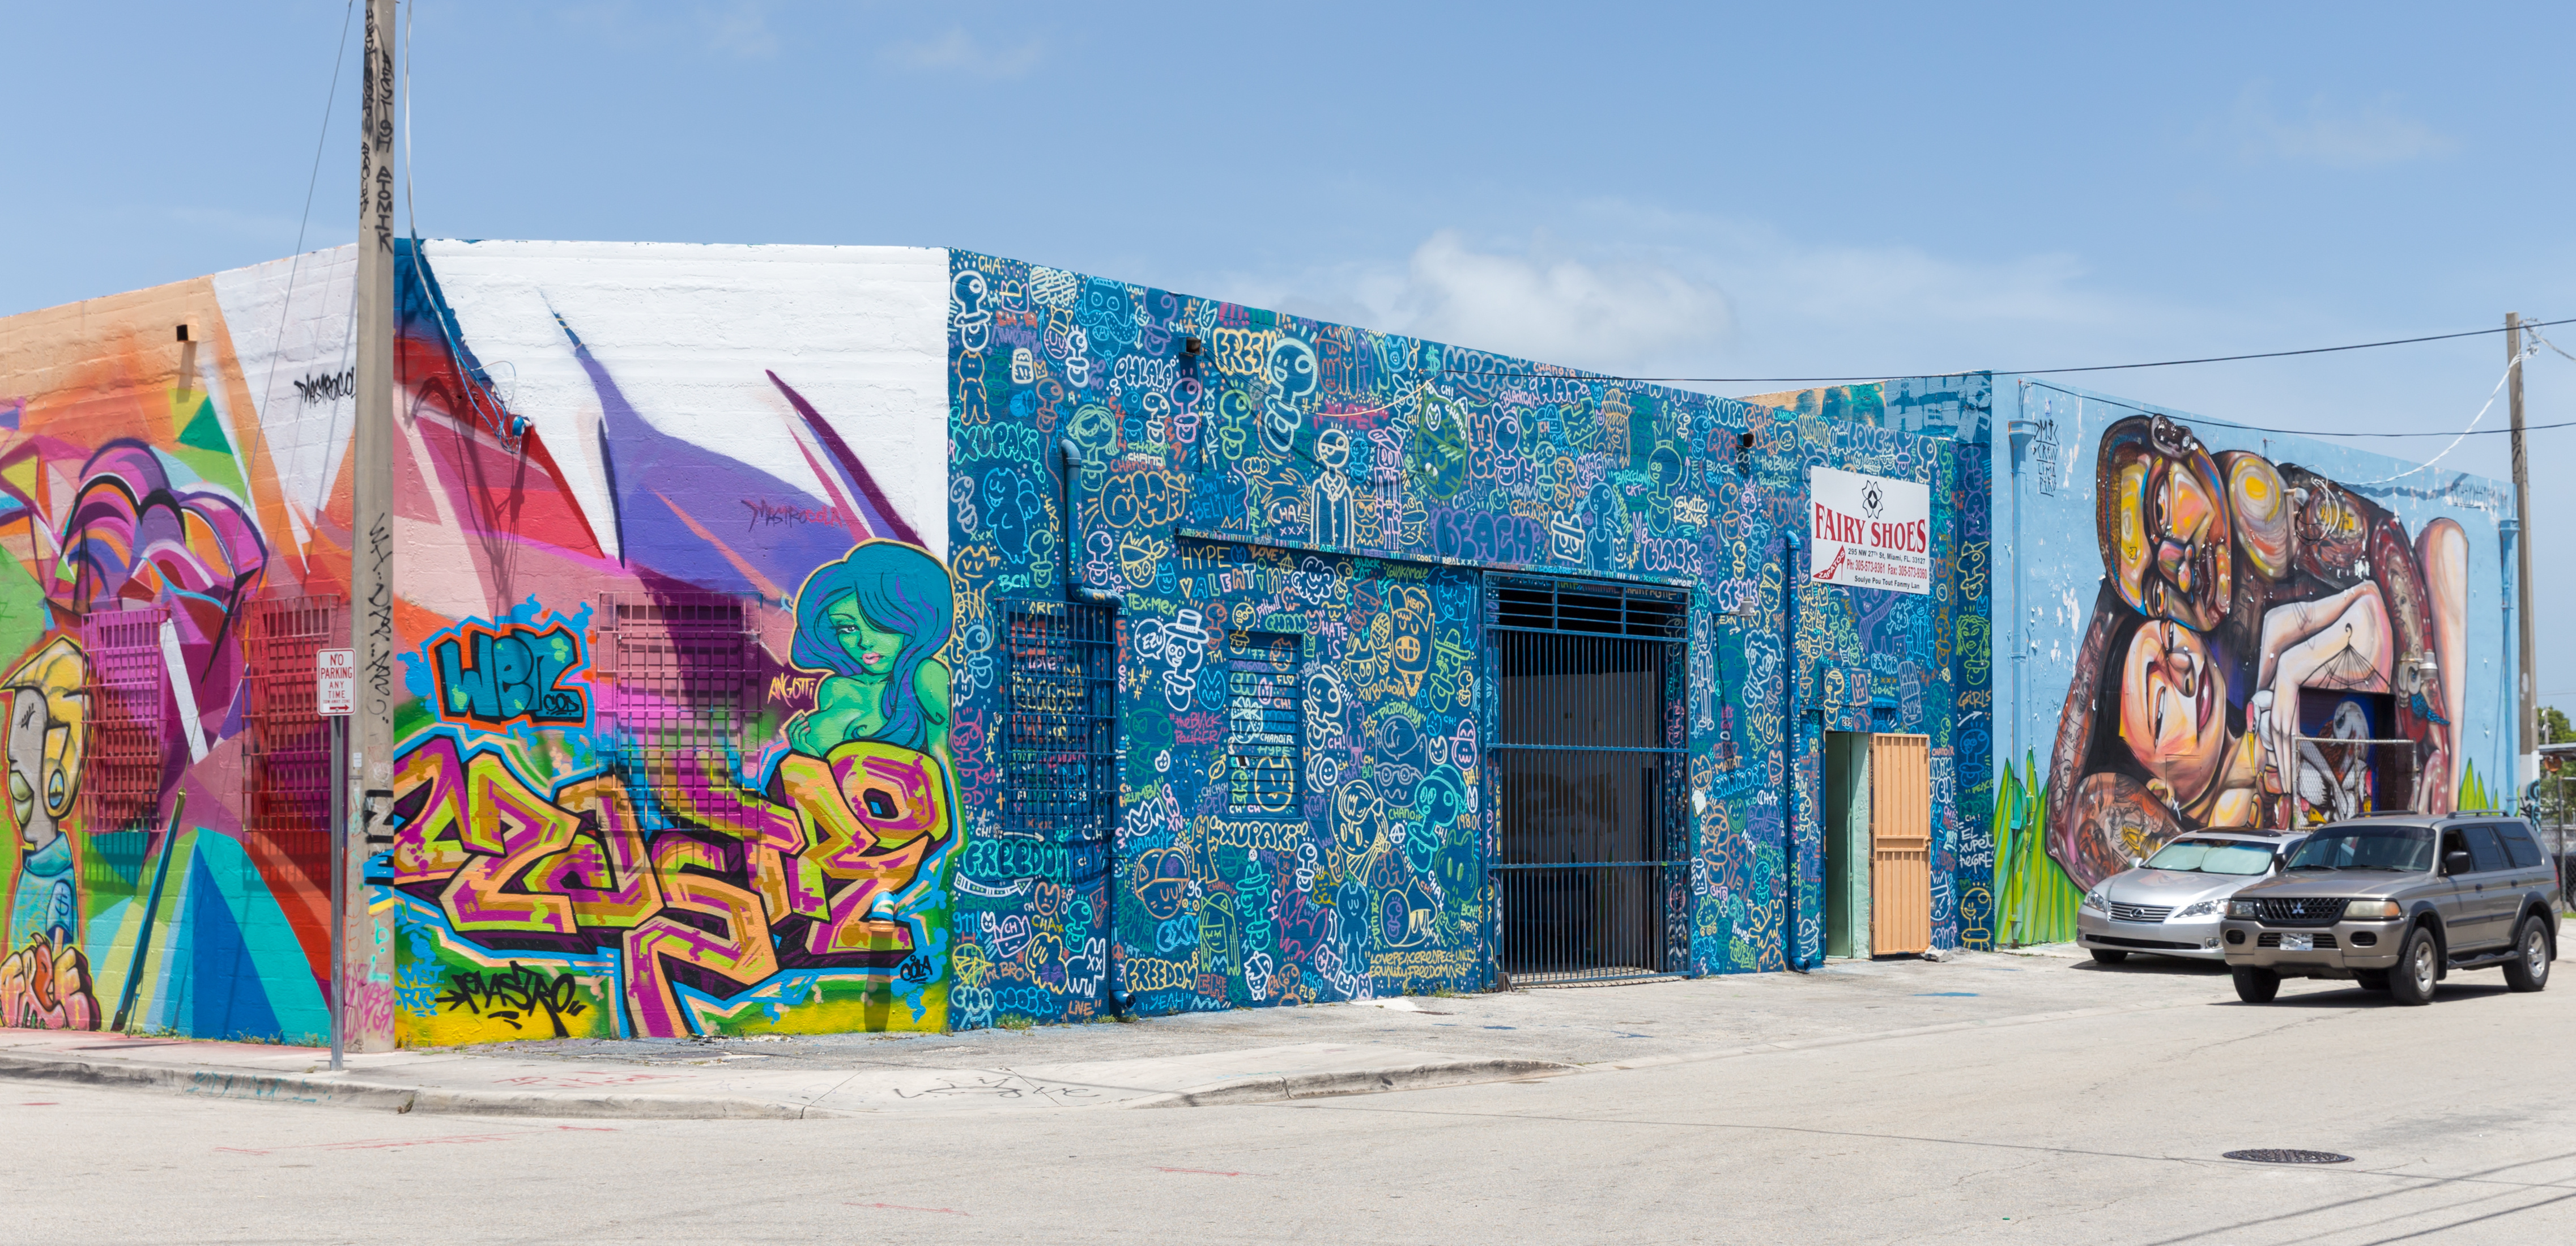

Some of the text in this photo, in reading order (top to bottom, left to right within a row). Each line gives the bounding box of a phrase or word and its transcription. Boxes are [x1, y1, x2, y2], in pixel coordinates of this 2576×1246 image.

[1815, 501, 1866, 545] FAIRY
[1871, 518, 1926, 554] SHOES
[1181, 545, 1232, 570] HYPE
[1819, 550, 1845, 579] ZAPATOS
[1887, 552, 1902, 563] Miami,
[1912, 556, 1926, 565] 33127
[1855, 559, 1885, 574] 305-573-9361
[1888, 563, 1897, 576] Fax:
[1898, 565, 1927, 580] 305-573-9360
[997, 572, 1030, 592] BCN
[1854, 575, 1871, 585] Soulye
[1894, 580, 1910, 589] Fanmy
[1407, 595, 1425, 614] HEAT
[1322, 620, 1348, 641] HATE
[330, 654, 344, 666] NO
[321, 667, 352, 679] PARKING
[328, 690, 345, 699] TIME
[1273, 697, 1292, 709] CH!
[1842, 716, 1853, 727] 295
[1124, 957, 1198, 993] FREEDOM
